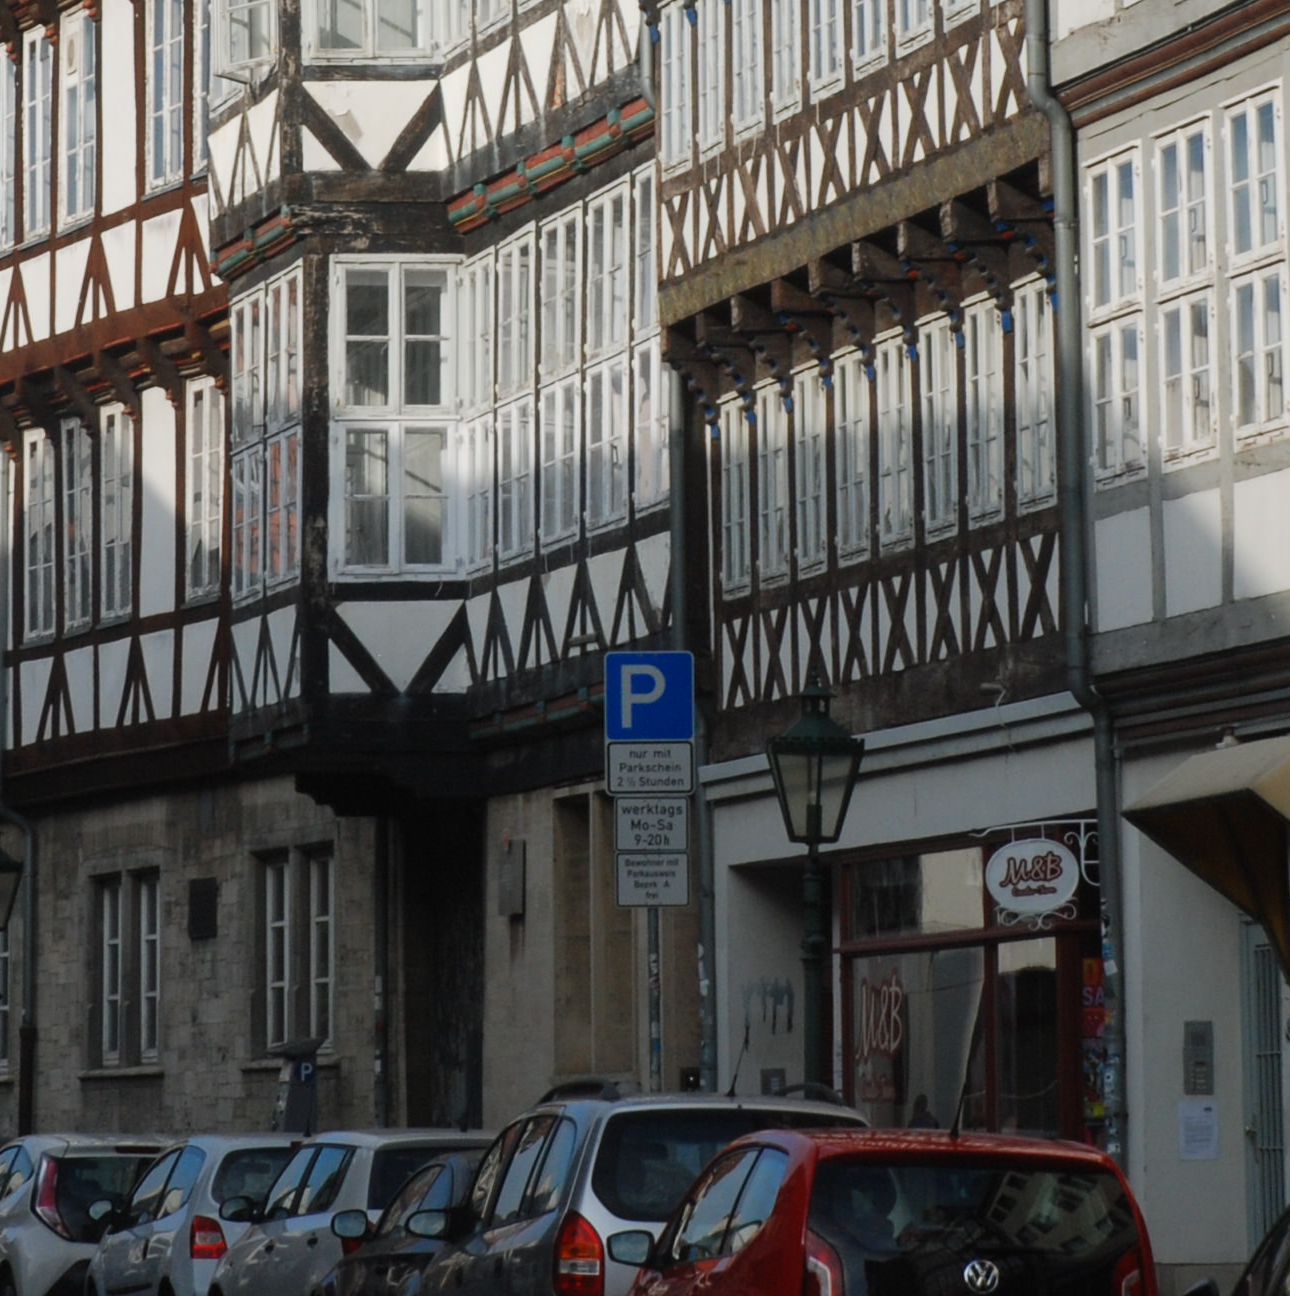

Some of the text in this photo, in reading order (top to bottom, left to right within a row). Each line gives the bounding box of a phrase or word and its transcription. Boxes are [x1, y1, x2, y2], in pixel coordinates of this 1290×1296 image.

[621, 664, 666, 728] P
[629, 749, 671, 759] nur mit
[619, 762, 682, 773] Parkschein
[617, 776, 623, 787] 2
[639, 776, 684, 787] Stunden
[621, 803, 683, 816] werktags
[630, 819, 673, 832] Mo-Sa
[624, 858, 665, 867] Bewohner
[300, 1062, 313, 1082] P
